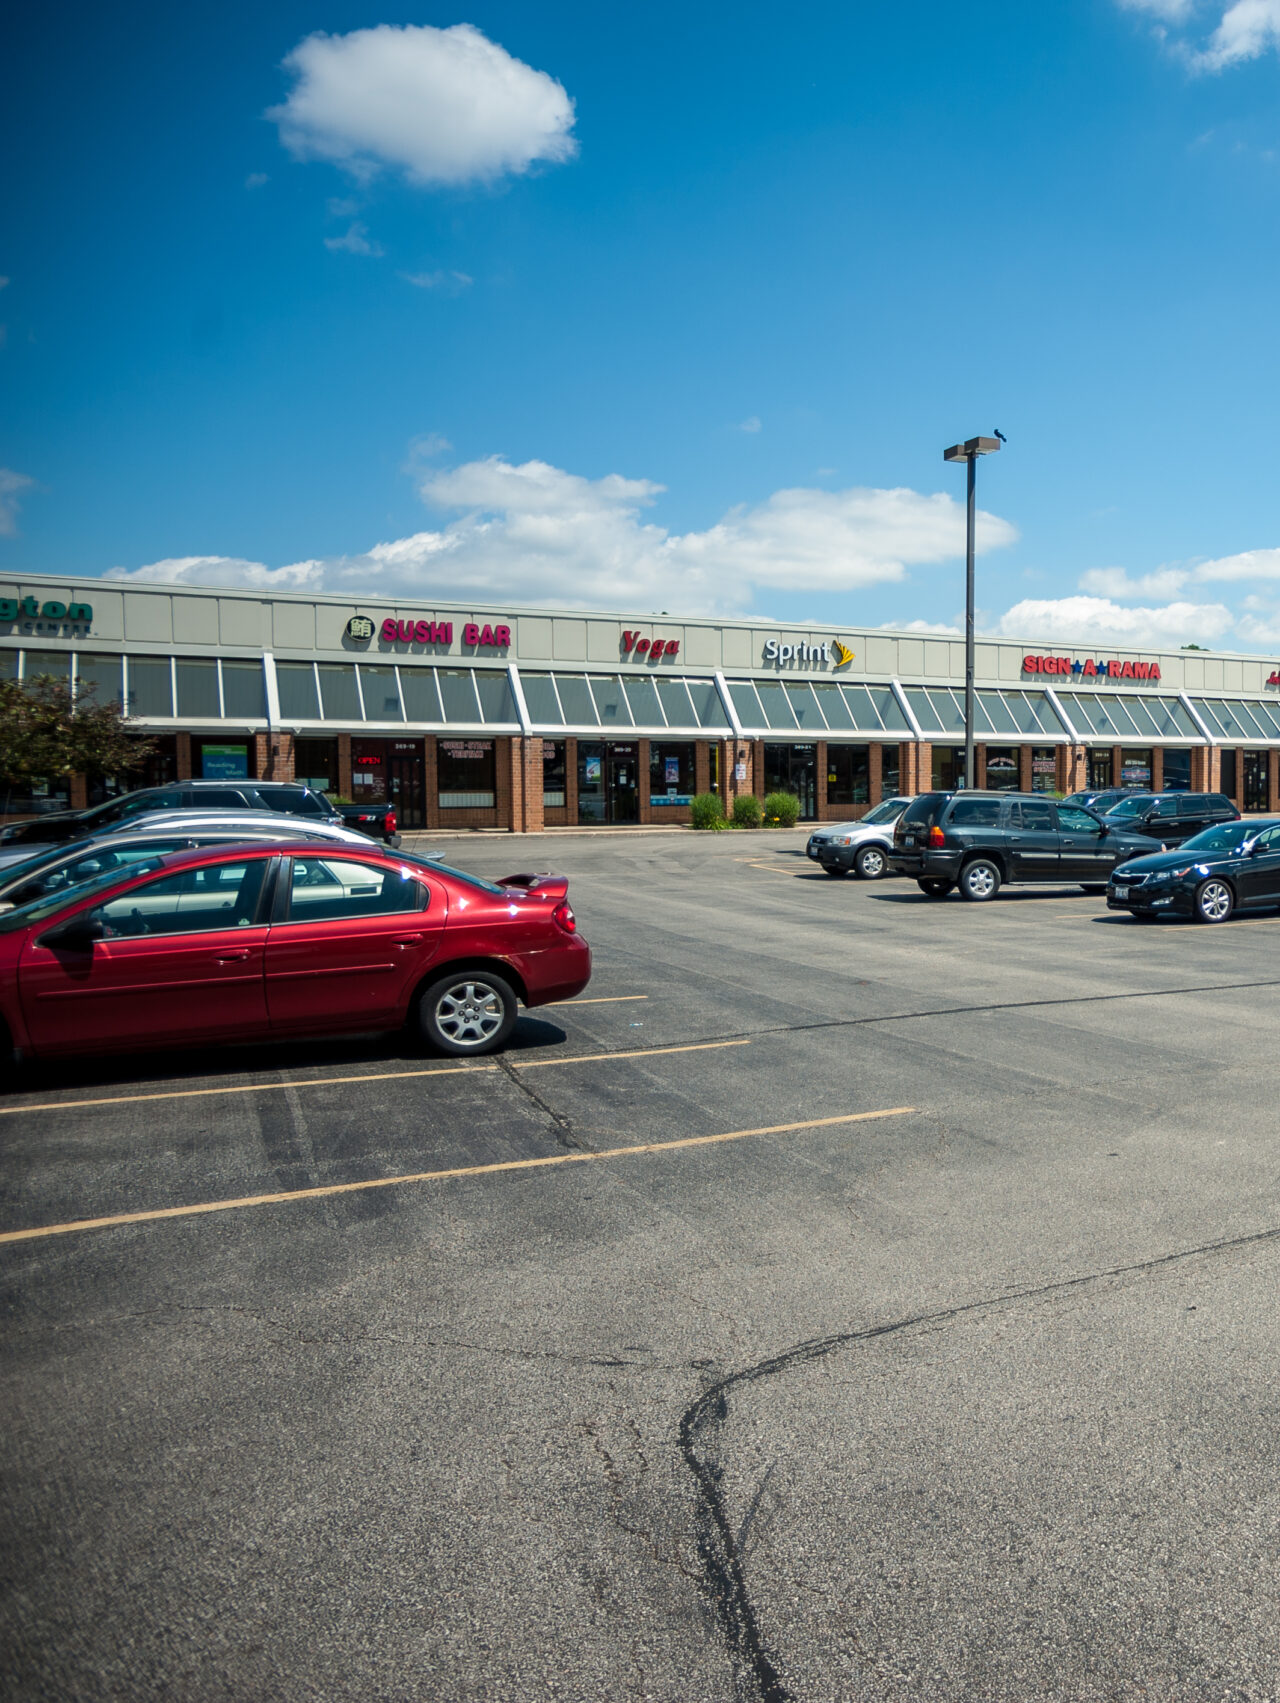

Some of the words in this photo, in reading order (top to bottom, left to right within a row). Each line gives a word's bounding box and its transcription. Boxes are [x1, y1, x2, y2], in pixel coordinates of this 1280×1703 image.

[381, 618, 453, 643] SUSHI
[465, 623, 511, 647] BAR
[622, 630, 680, 659] Yoga
[765, 638, 831, 665] Sprint
[1023, 655, 1071, 675] SIGN
[1083, 659, 1097, 676] A
[1107, 660, 1161, 680] RAMA
[358, 756, 381, 765] OPEN
